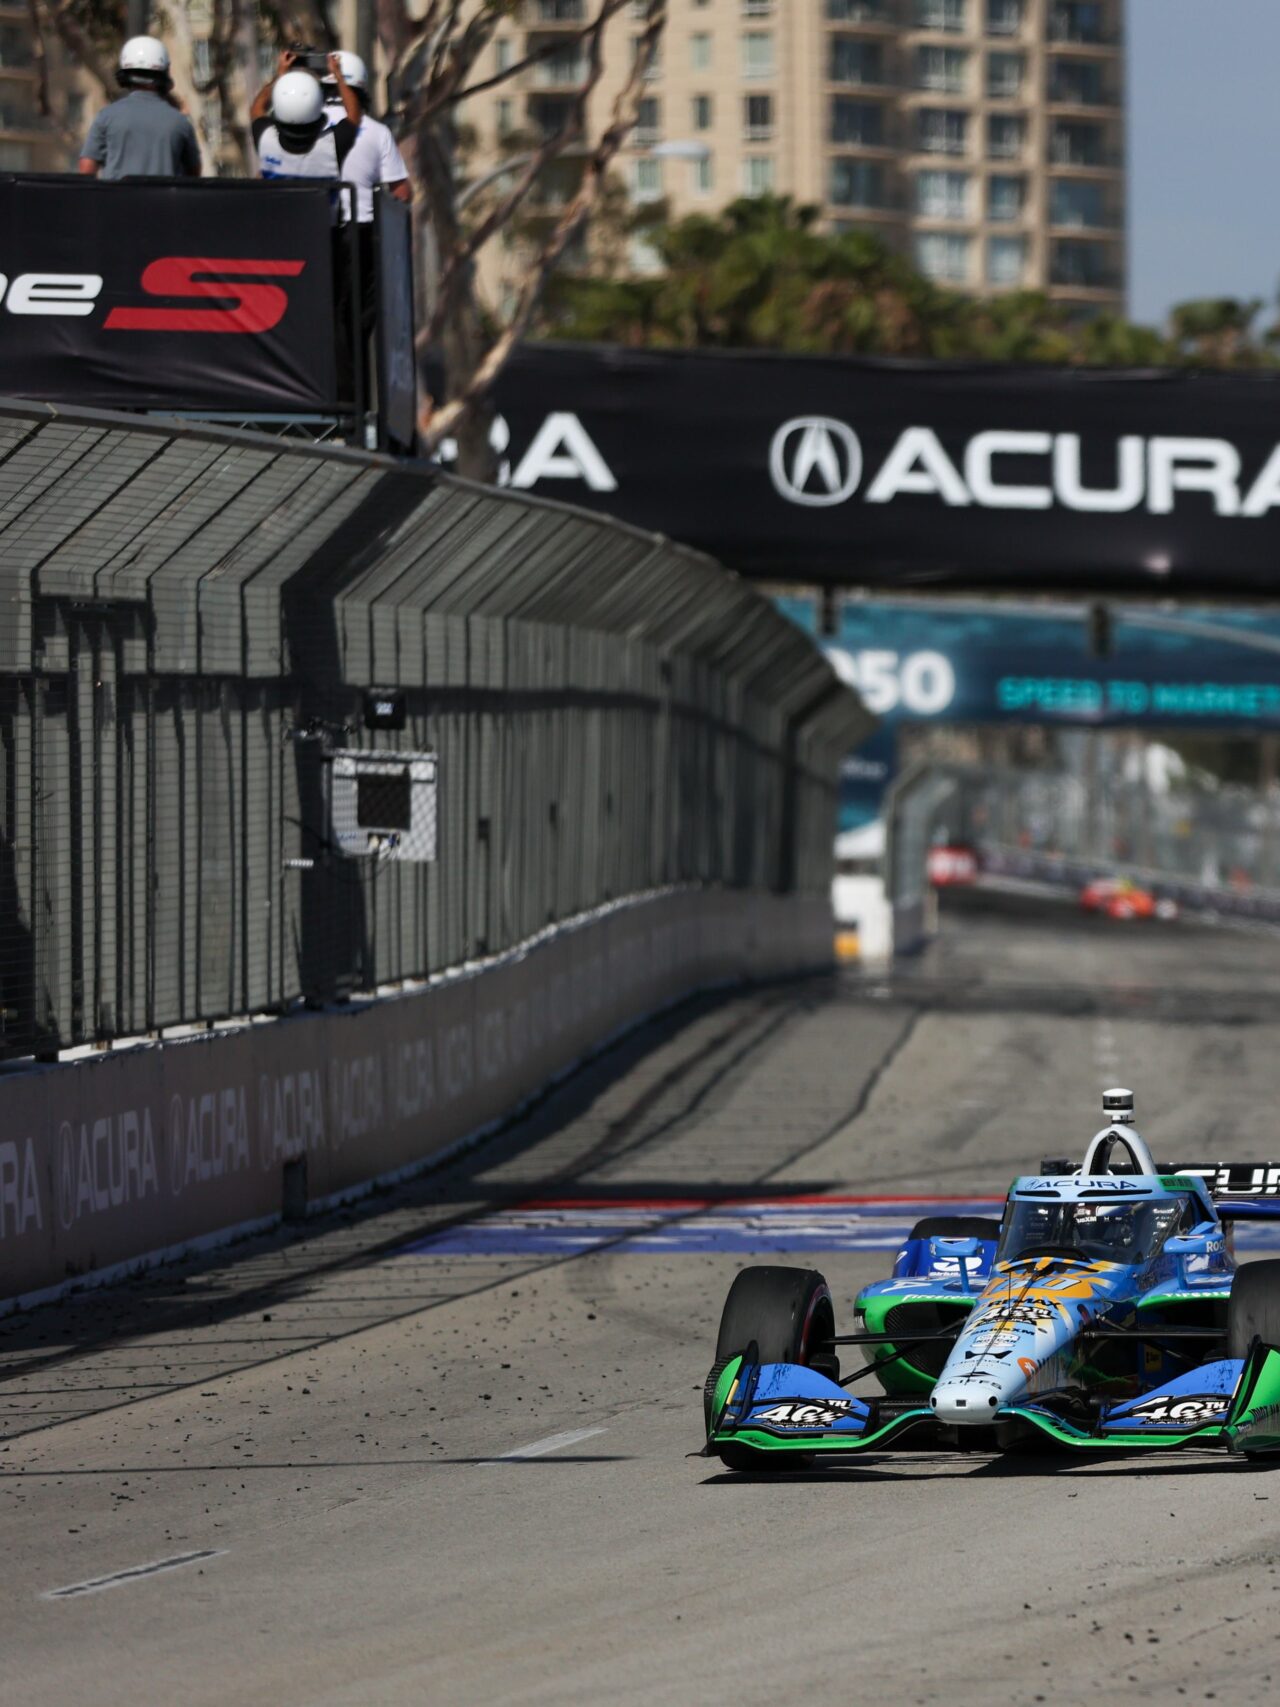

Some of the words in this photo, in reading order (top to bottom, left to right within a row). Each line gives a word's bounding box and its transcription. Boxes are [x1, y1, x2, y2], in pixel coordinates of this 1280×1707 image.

[0, 272, 103, 316] e
[102, 257, 307, 333] S
[998, 675, 1102, 712] SPEED
[1107, 679, 1148, 713] TO
[75, 1107, 160, 1219] ACURA
[183, 1083, 251, 1186] ACURA
[1034, 1180, 1138, 1190] ACURA
